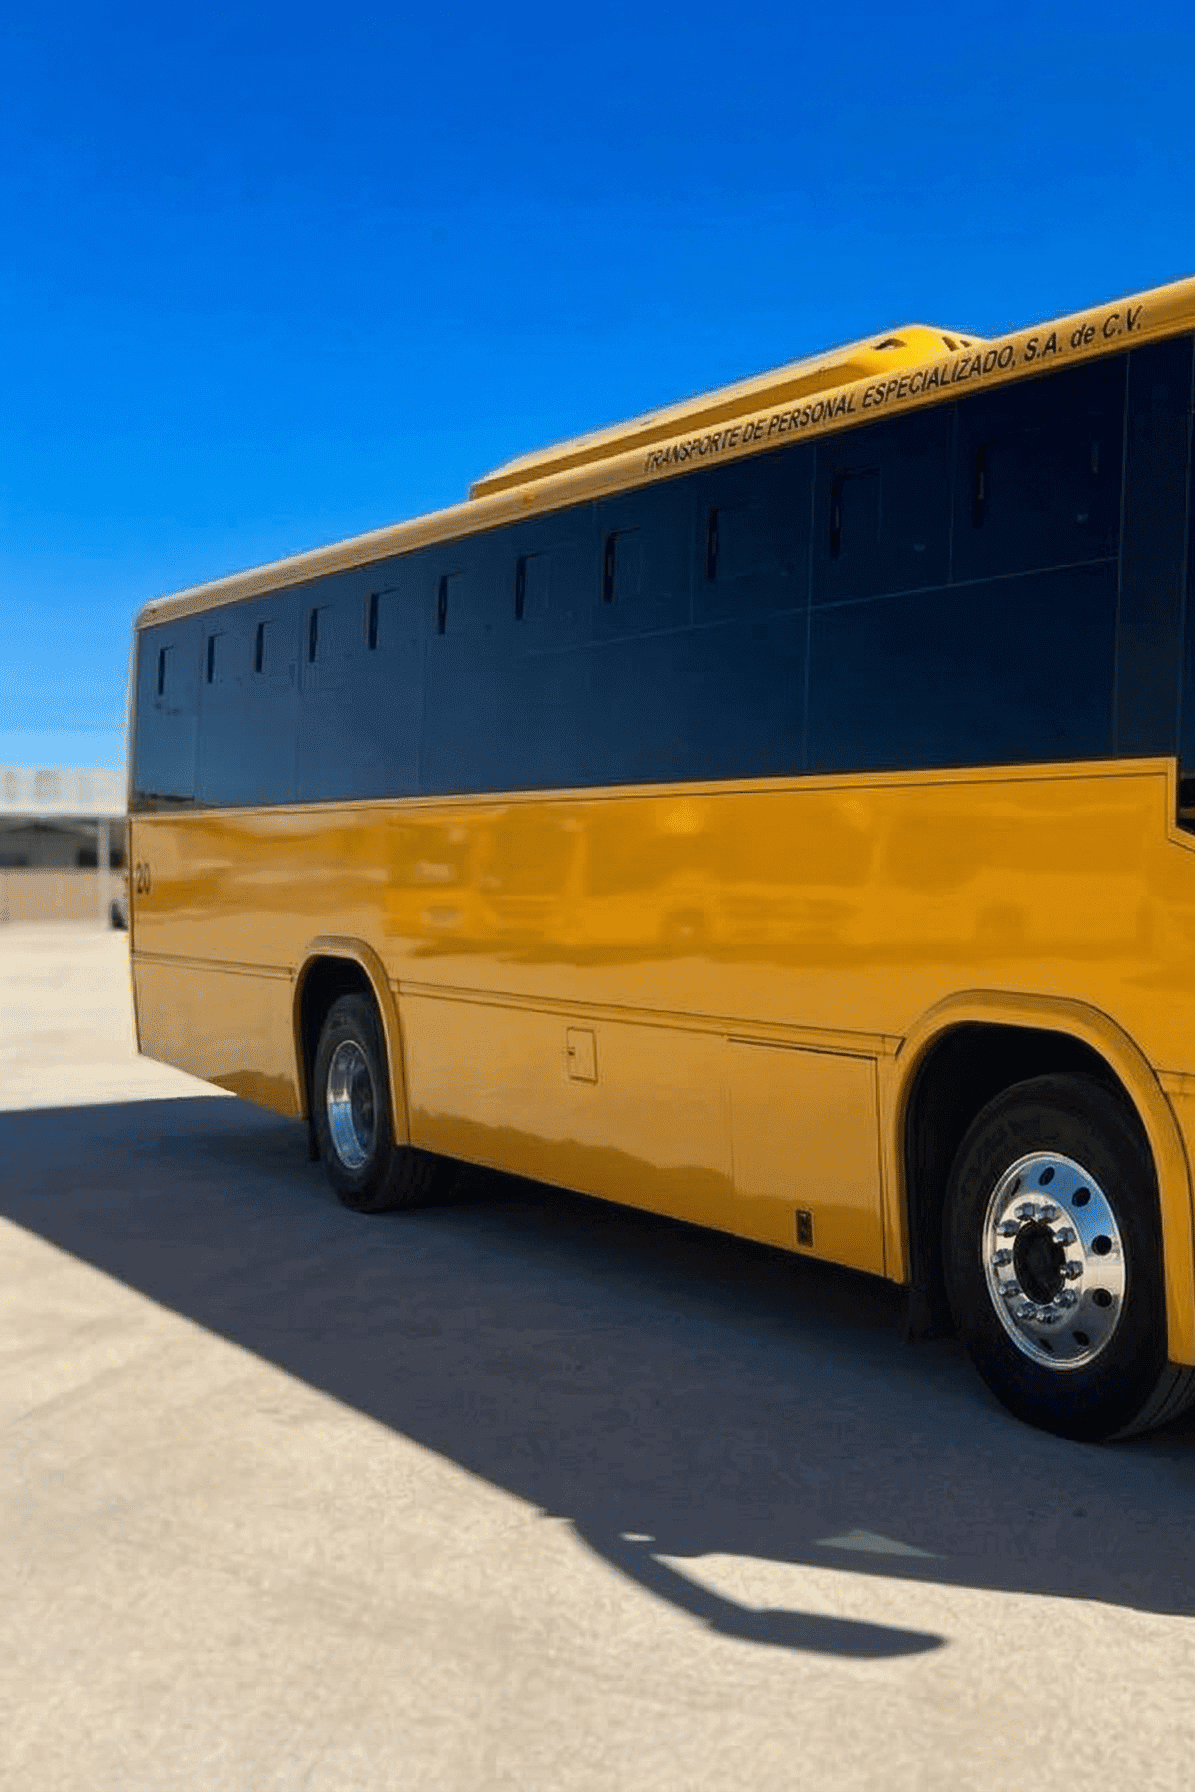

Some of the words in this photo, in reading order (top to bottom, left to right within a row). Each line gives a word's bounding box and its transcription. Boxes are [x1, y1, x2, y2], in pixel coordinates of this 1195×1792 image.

[643, 425, 742, 474] TRANSPORTE
[742, 418, 768, 443] DE
[767, 393, 857, 437] PERSONAL
[861, 345, 1016, 409] ESPECIALIZADO,
[1024, 331, 1062, 362] S.A.
[1070, 323, 1095, 349] de
[1103, 305, 1143, 339] C.V.
